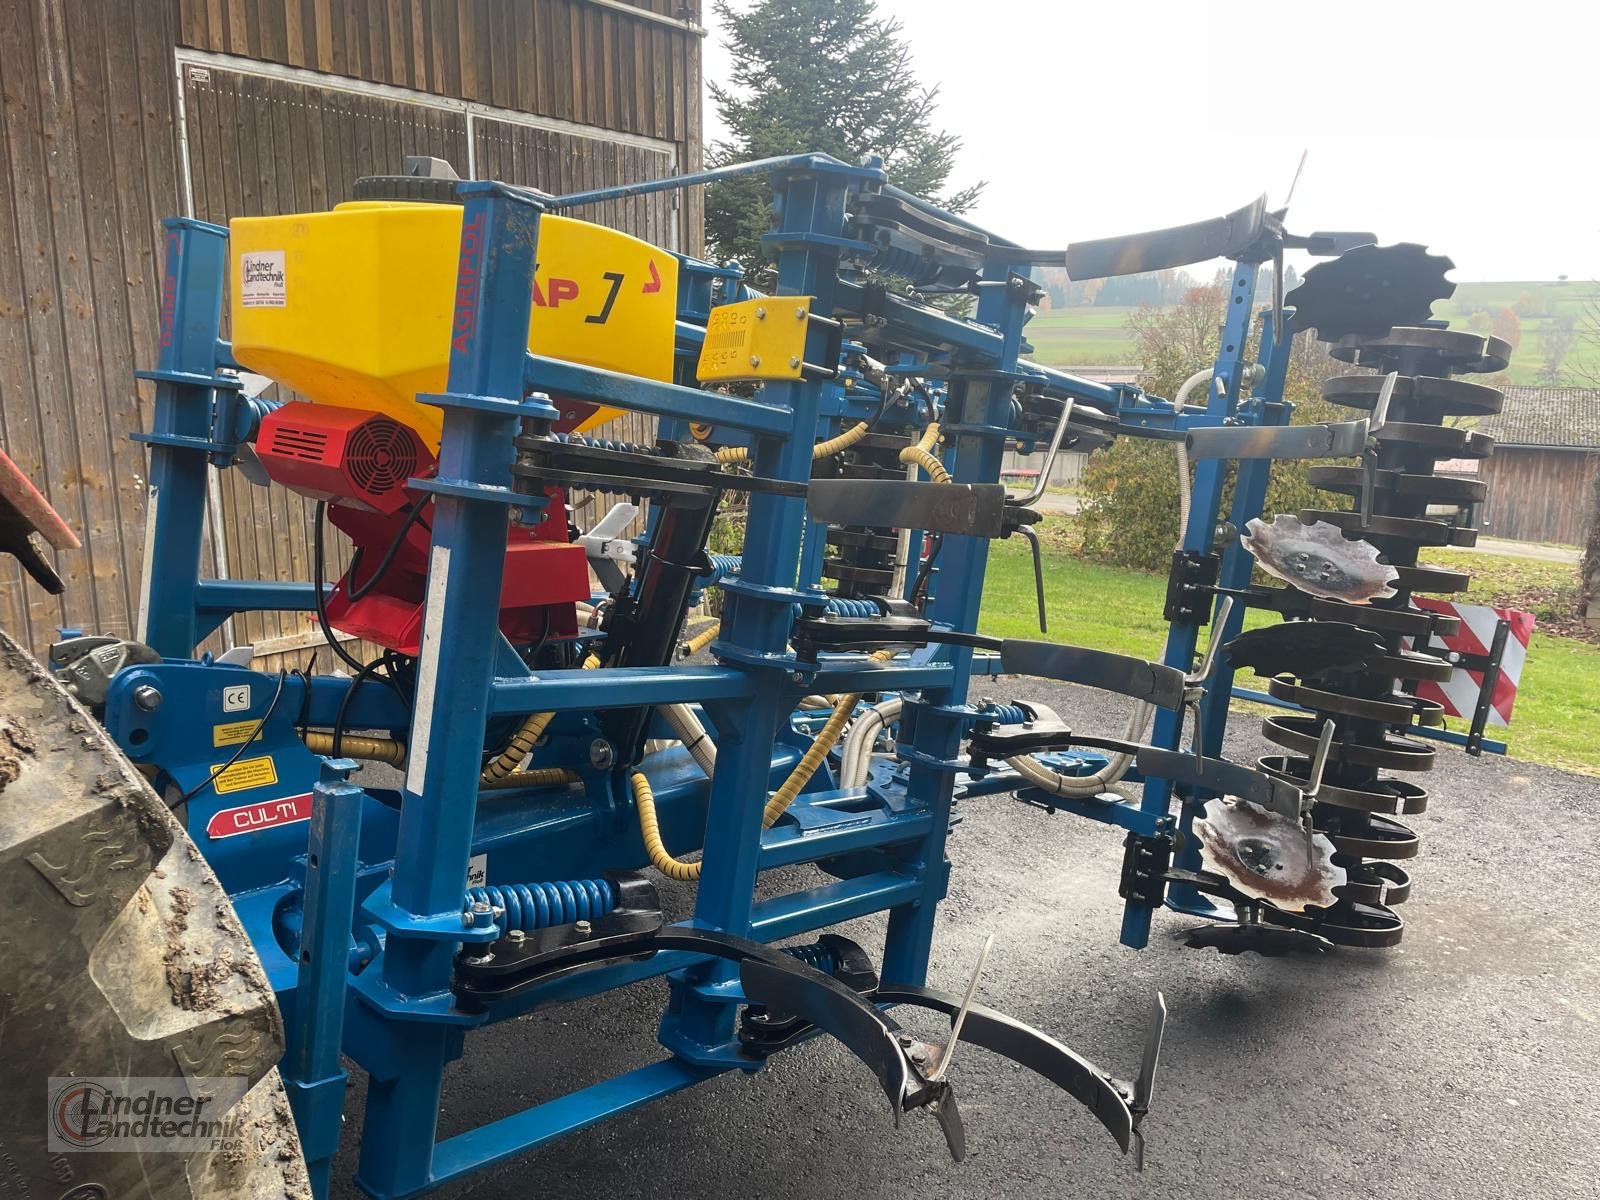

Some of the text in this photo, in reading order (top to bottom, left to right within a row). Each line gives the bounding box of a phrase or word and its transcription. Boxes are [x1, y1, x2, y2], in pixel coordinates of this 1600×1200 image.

[246, 260, 274, 272] Lindner
[246, 271, 284, 283] Landtechnik
[453, 211, 483, 353] AGRIPOL
[227, 691, 245, 705] CE
[233, 801, 297, 828] CULTI
